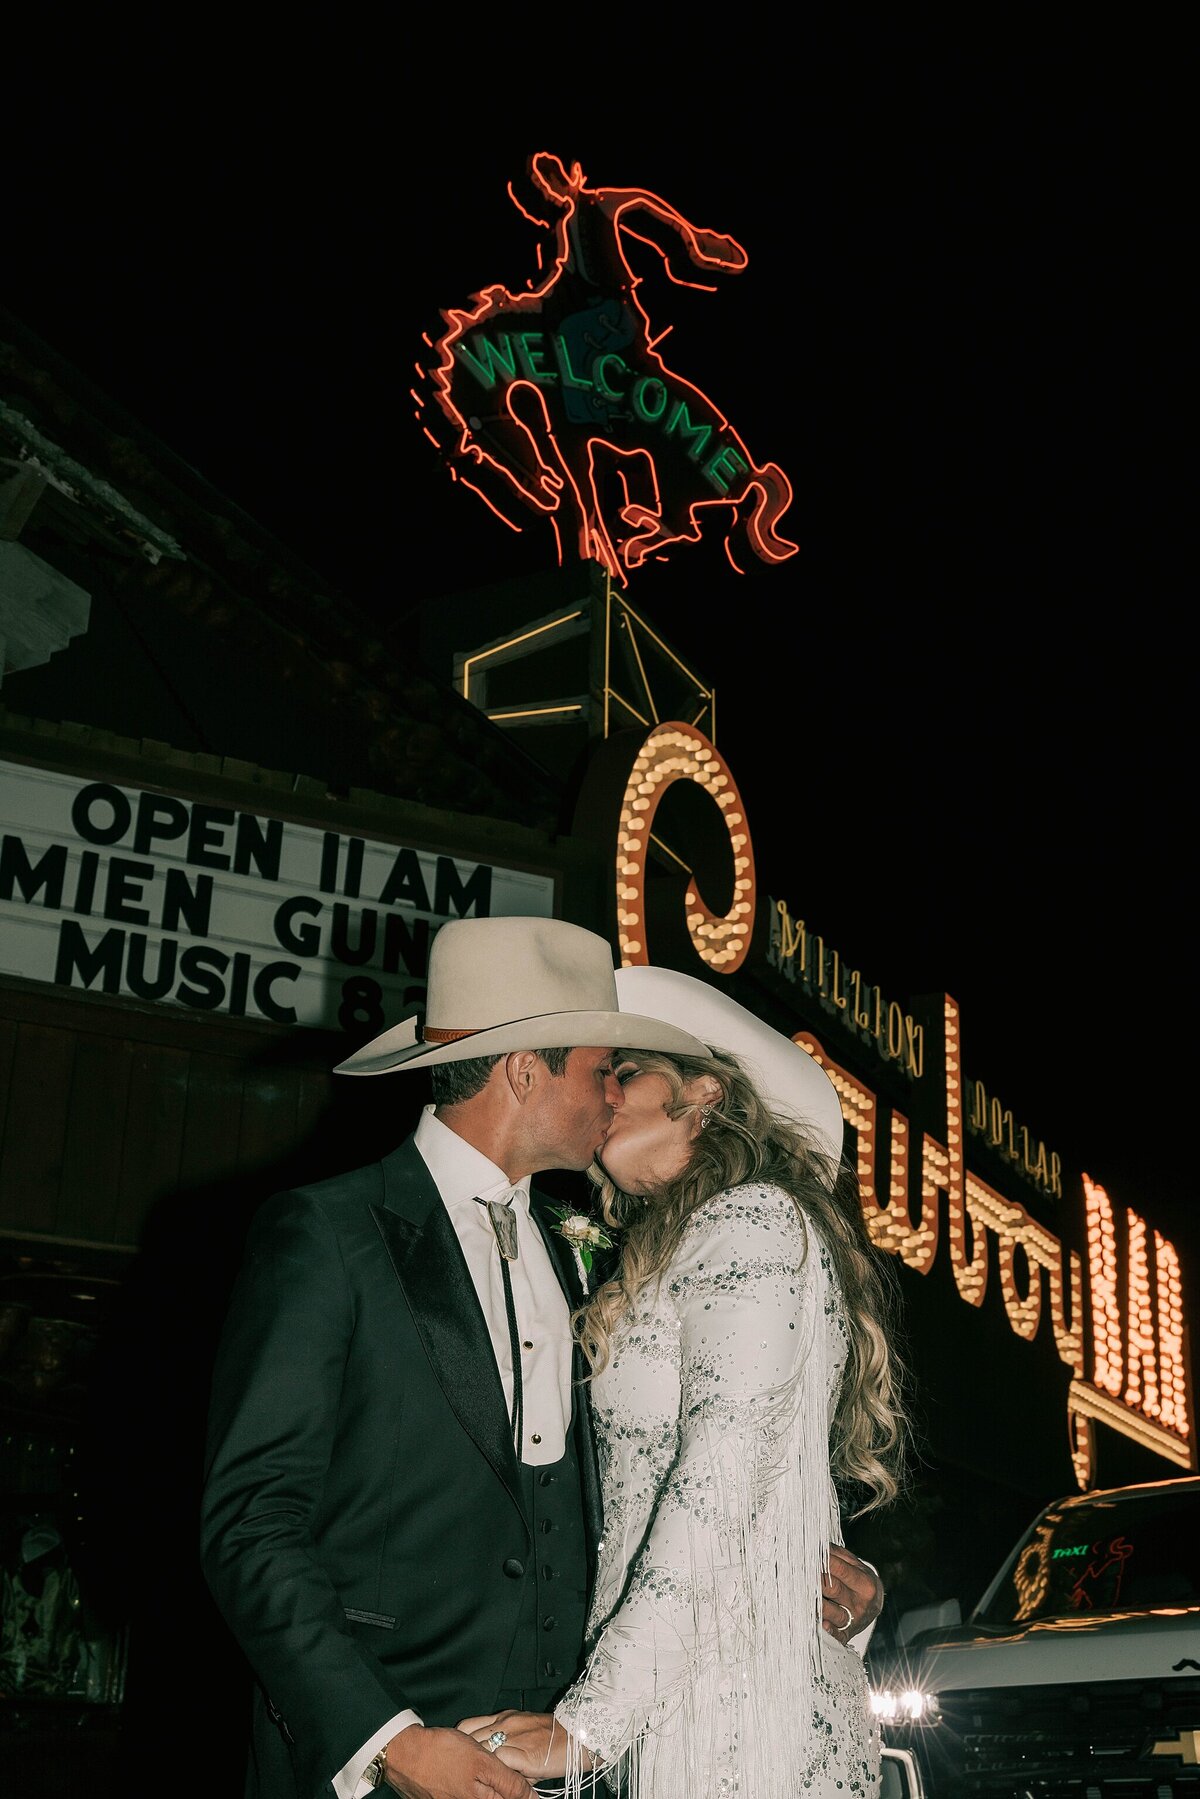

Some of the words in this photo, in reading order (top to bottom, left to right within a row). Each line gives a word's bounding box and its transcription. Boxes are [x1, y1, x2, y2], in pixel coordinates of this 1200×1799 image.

[456, 332, 750, 494] WELCOME
[0, 834, 215, 938] MIEN
[273, 896, 445, 980] GUN
[71, 782, 284, 882] OPEN
[54, 919, 301, 1025] MUSIC
[767, 895, 924, 1079] MILLION
[967, 1078, 1062, 1200] DOLLAR
[615, 720, 1097, 1491] Cwboy
